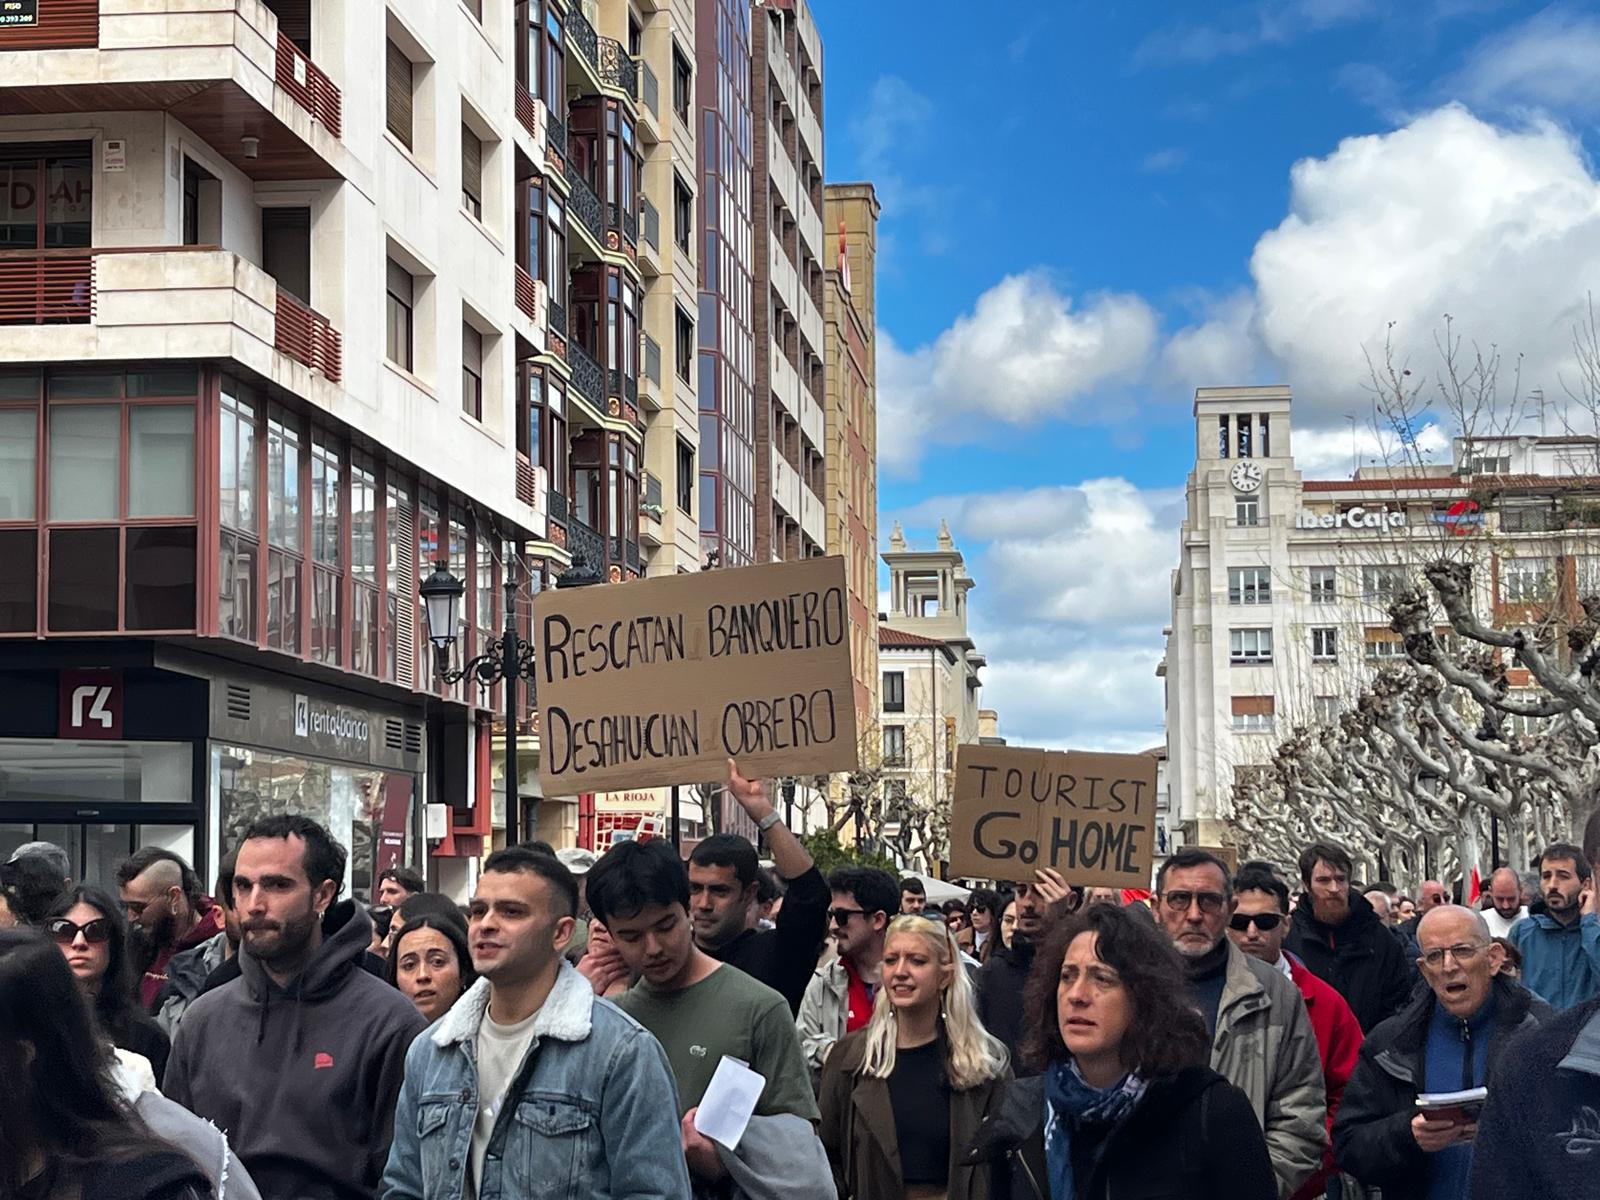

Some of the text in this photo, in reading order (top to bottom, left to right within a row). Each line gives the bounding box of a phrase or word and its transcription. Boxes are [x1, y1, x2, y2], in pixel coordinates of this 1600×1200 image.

[543, 613, 685, 683] RESCATAN
[708, 587, 844, 657] BANQUERO
[547, 706, 699, 775] DESAHUCIAN
[722, 688, 836, 756] OBRERO
[605, 792, 656, 802] LA RIOJA
[967, 765, 1147, 815] TOURIST
[1050, 817, 1146, 873] HOME
